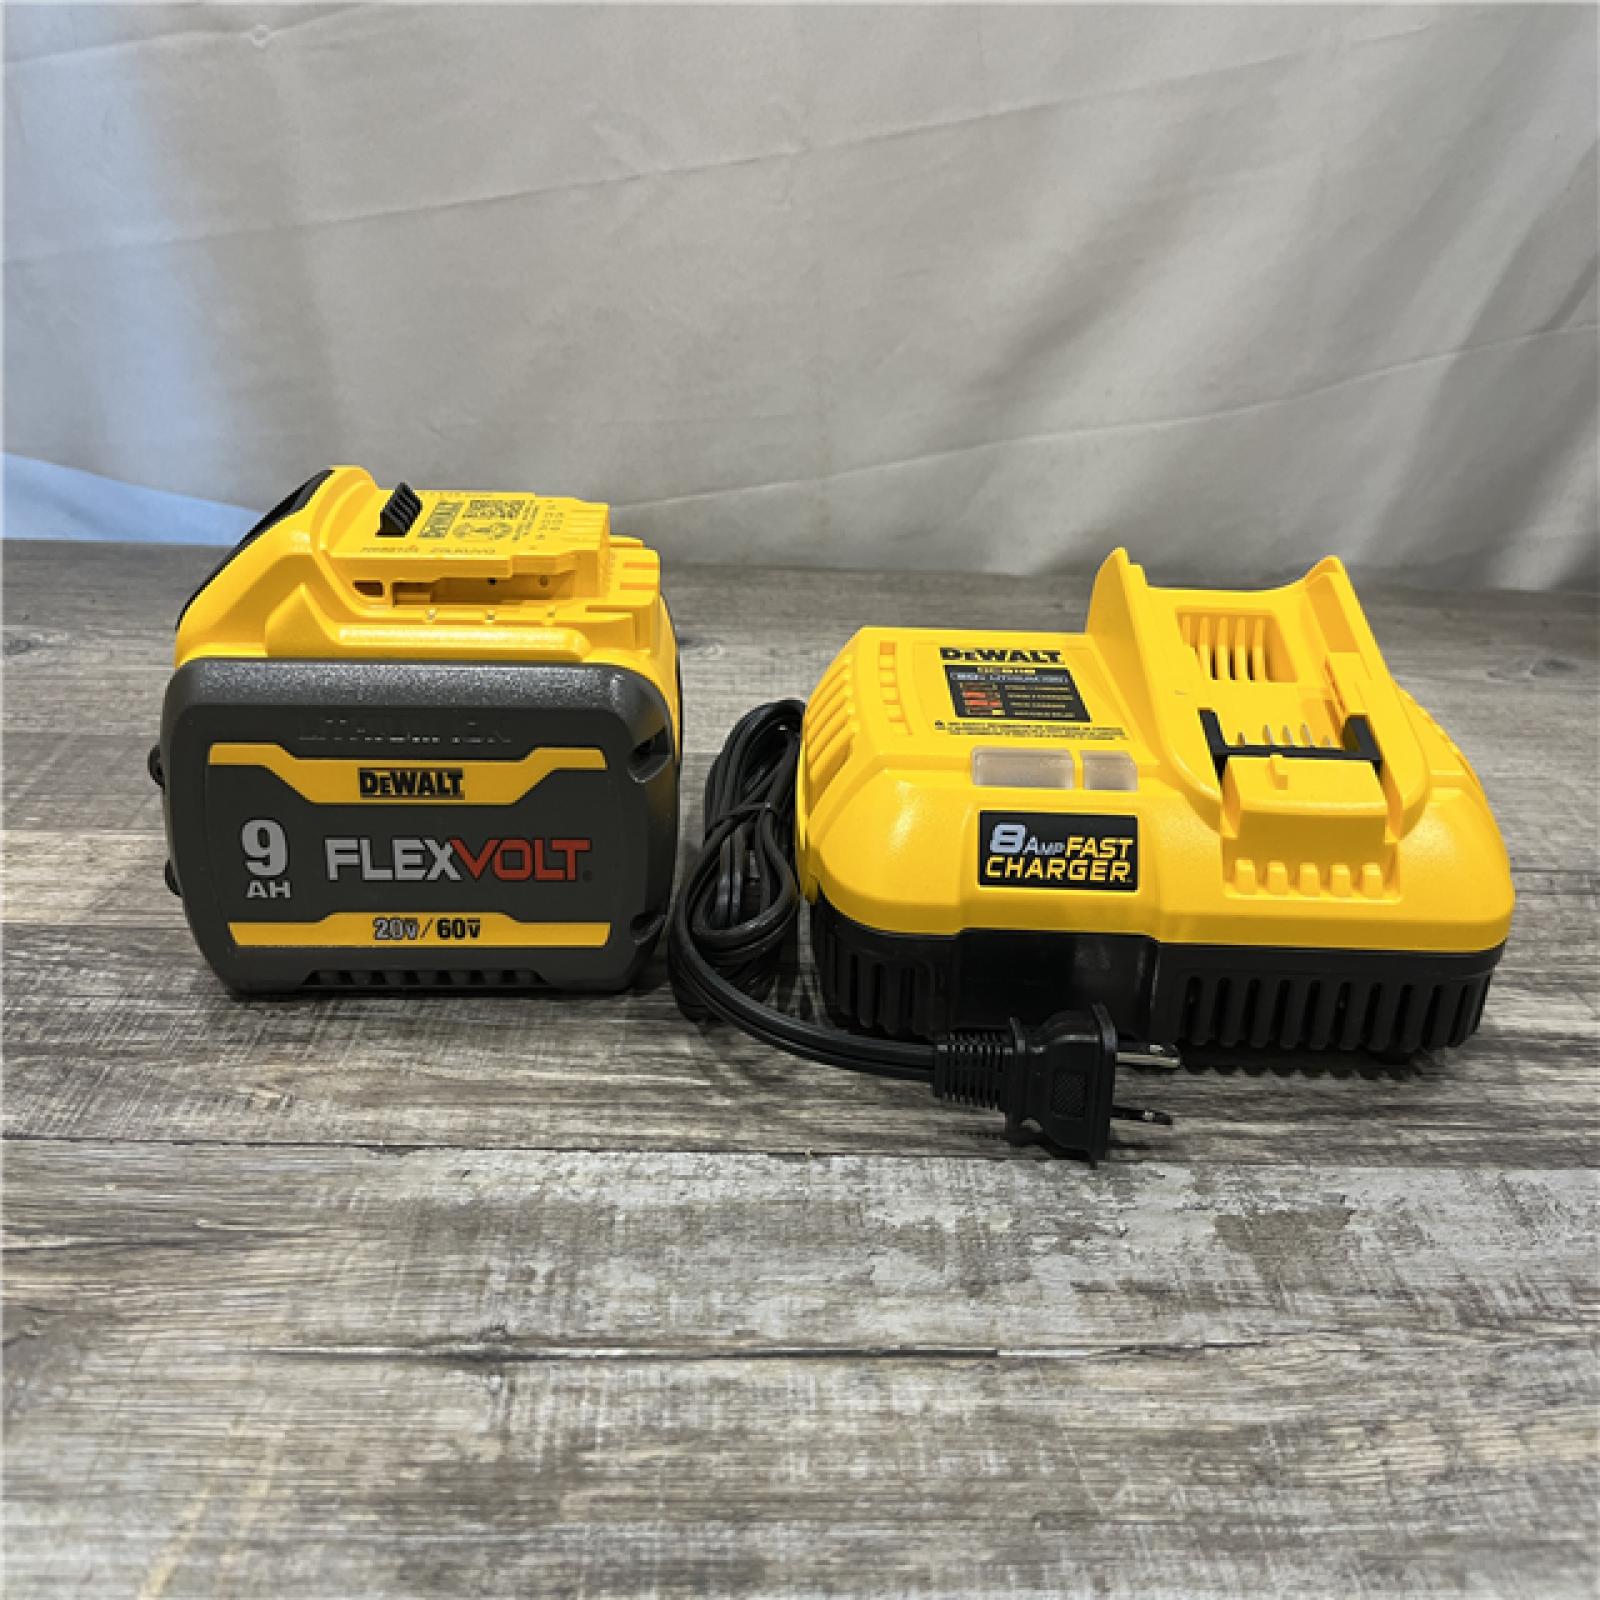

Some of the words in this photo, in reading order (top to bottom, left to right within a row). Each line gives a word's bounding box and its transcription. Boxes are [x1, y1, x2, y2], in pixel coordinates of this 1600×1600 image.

[240, 818, 289, 877] 9
[989, 823, 1027, 853] 8
[1064, 836, 1134, 859] FAST
[985, 855, 1131, 883] CHARGER
[246, 880, 291, 899] AH
